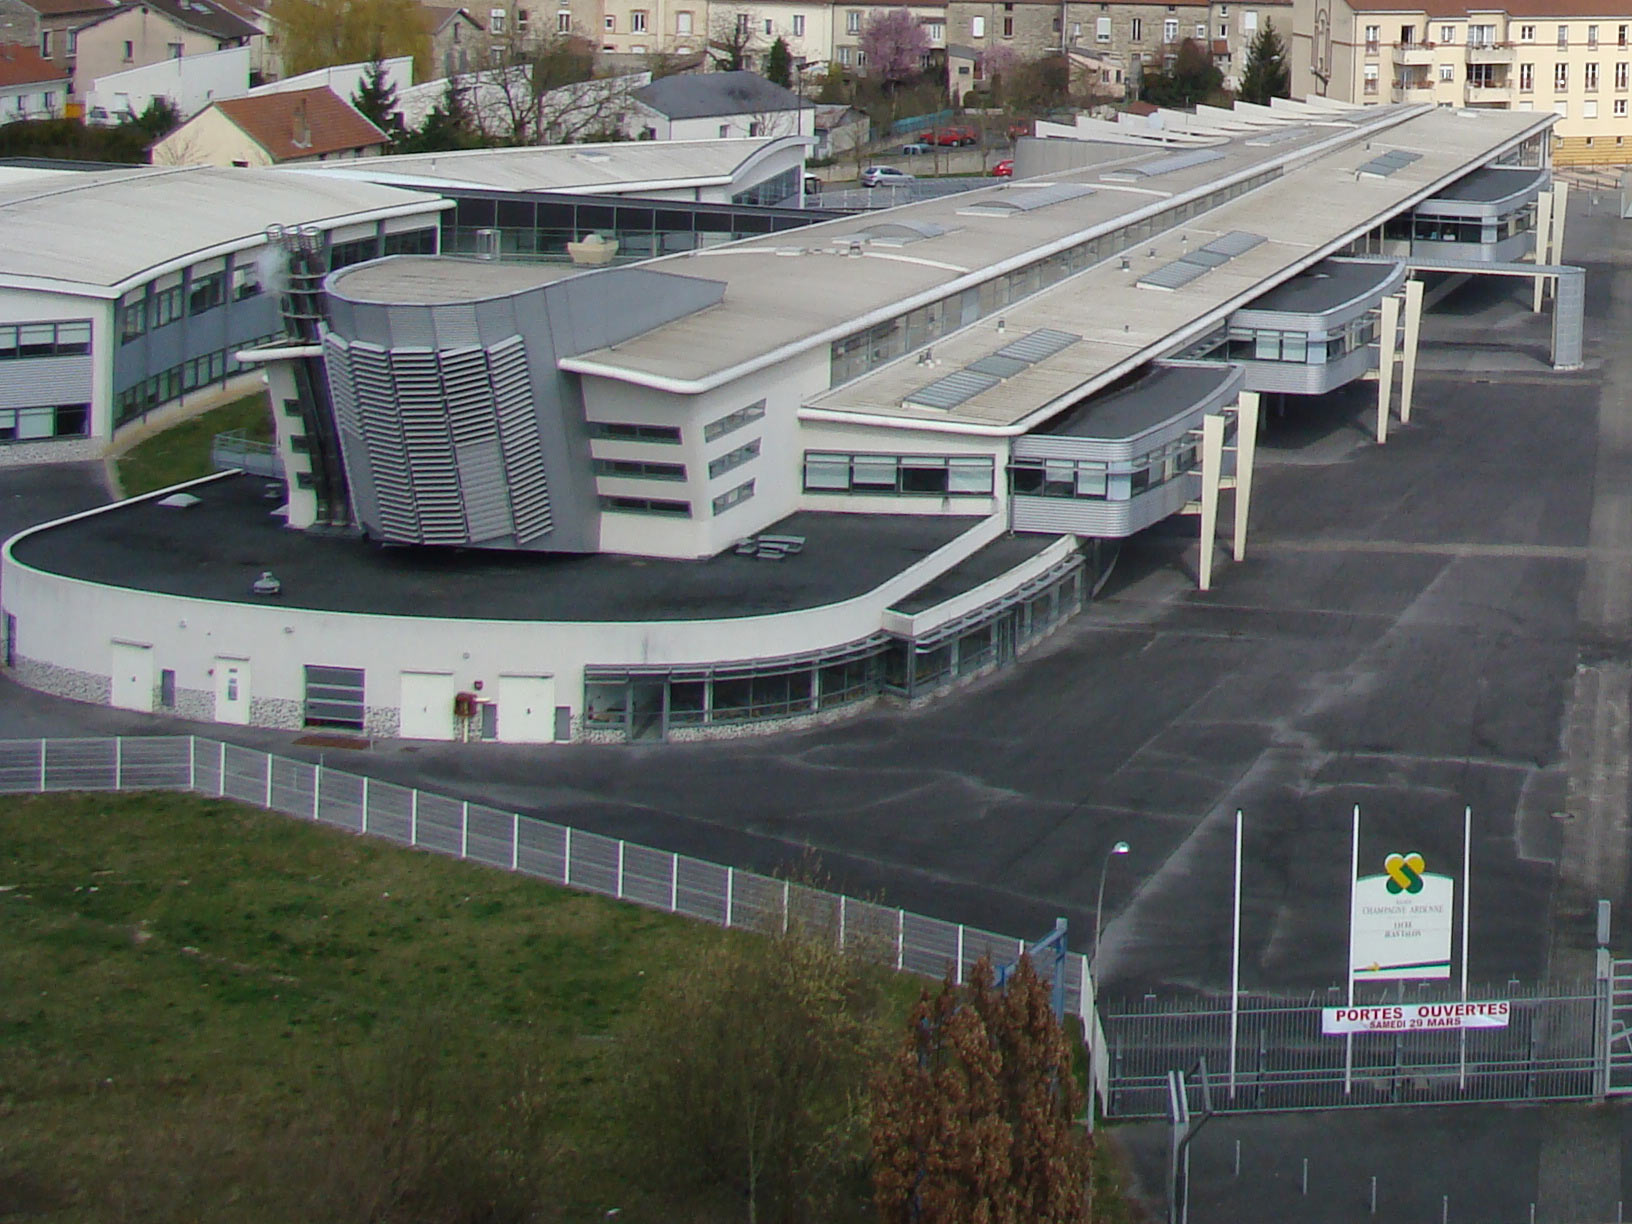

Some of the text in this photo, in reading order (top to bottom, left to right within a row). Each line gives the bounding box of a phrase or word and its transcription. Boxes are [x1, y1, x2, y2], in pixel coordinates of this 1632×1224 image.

[1336, 1003, 1508, 1021] PORTES OUVERTES
[1369, 1017, 1461, 1029] SAMEDI 29 MARS
